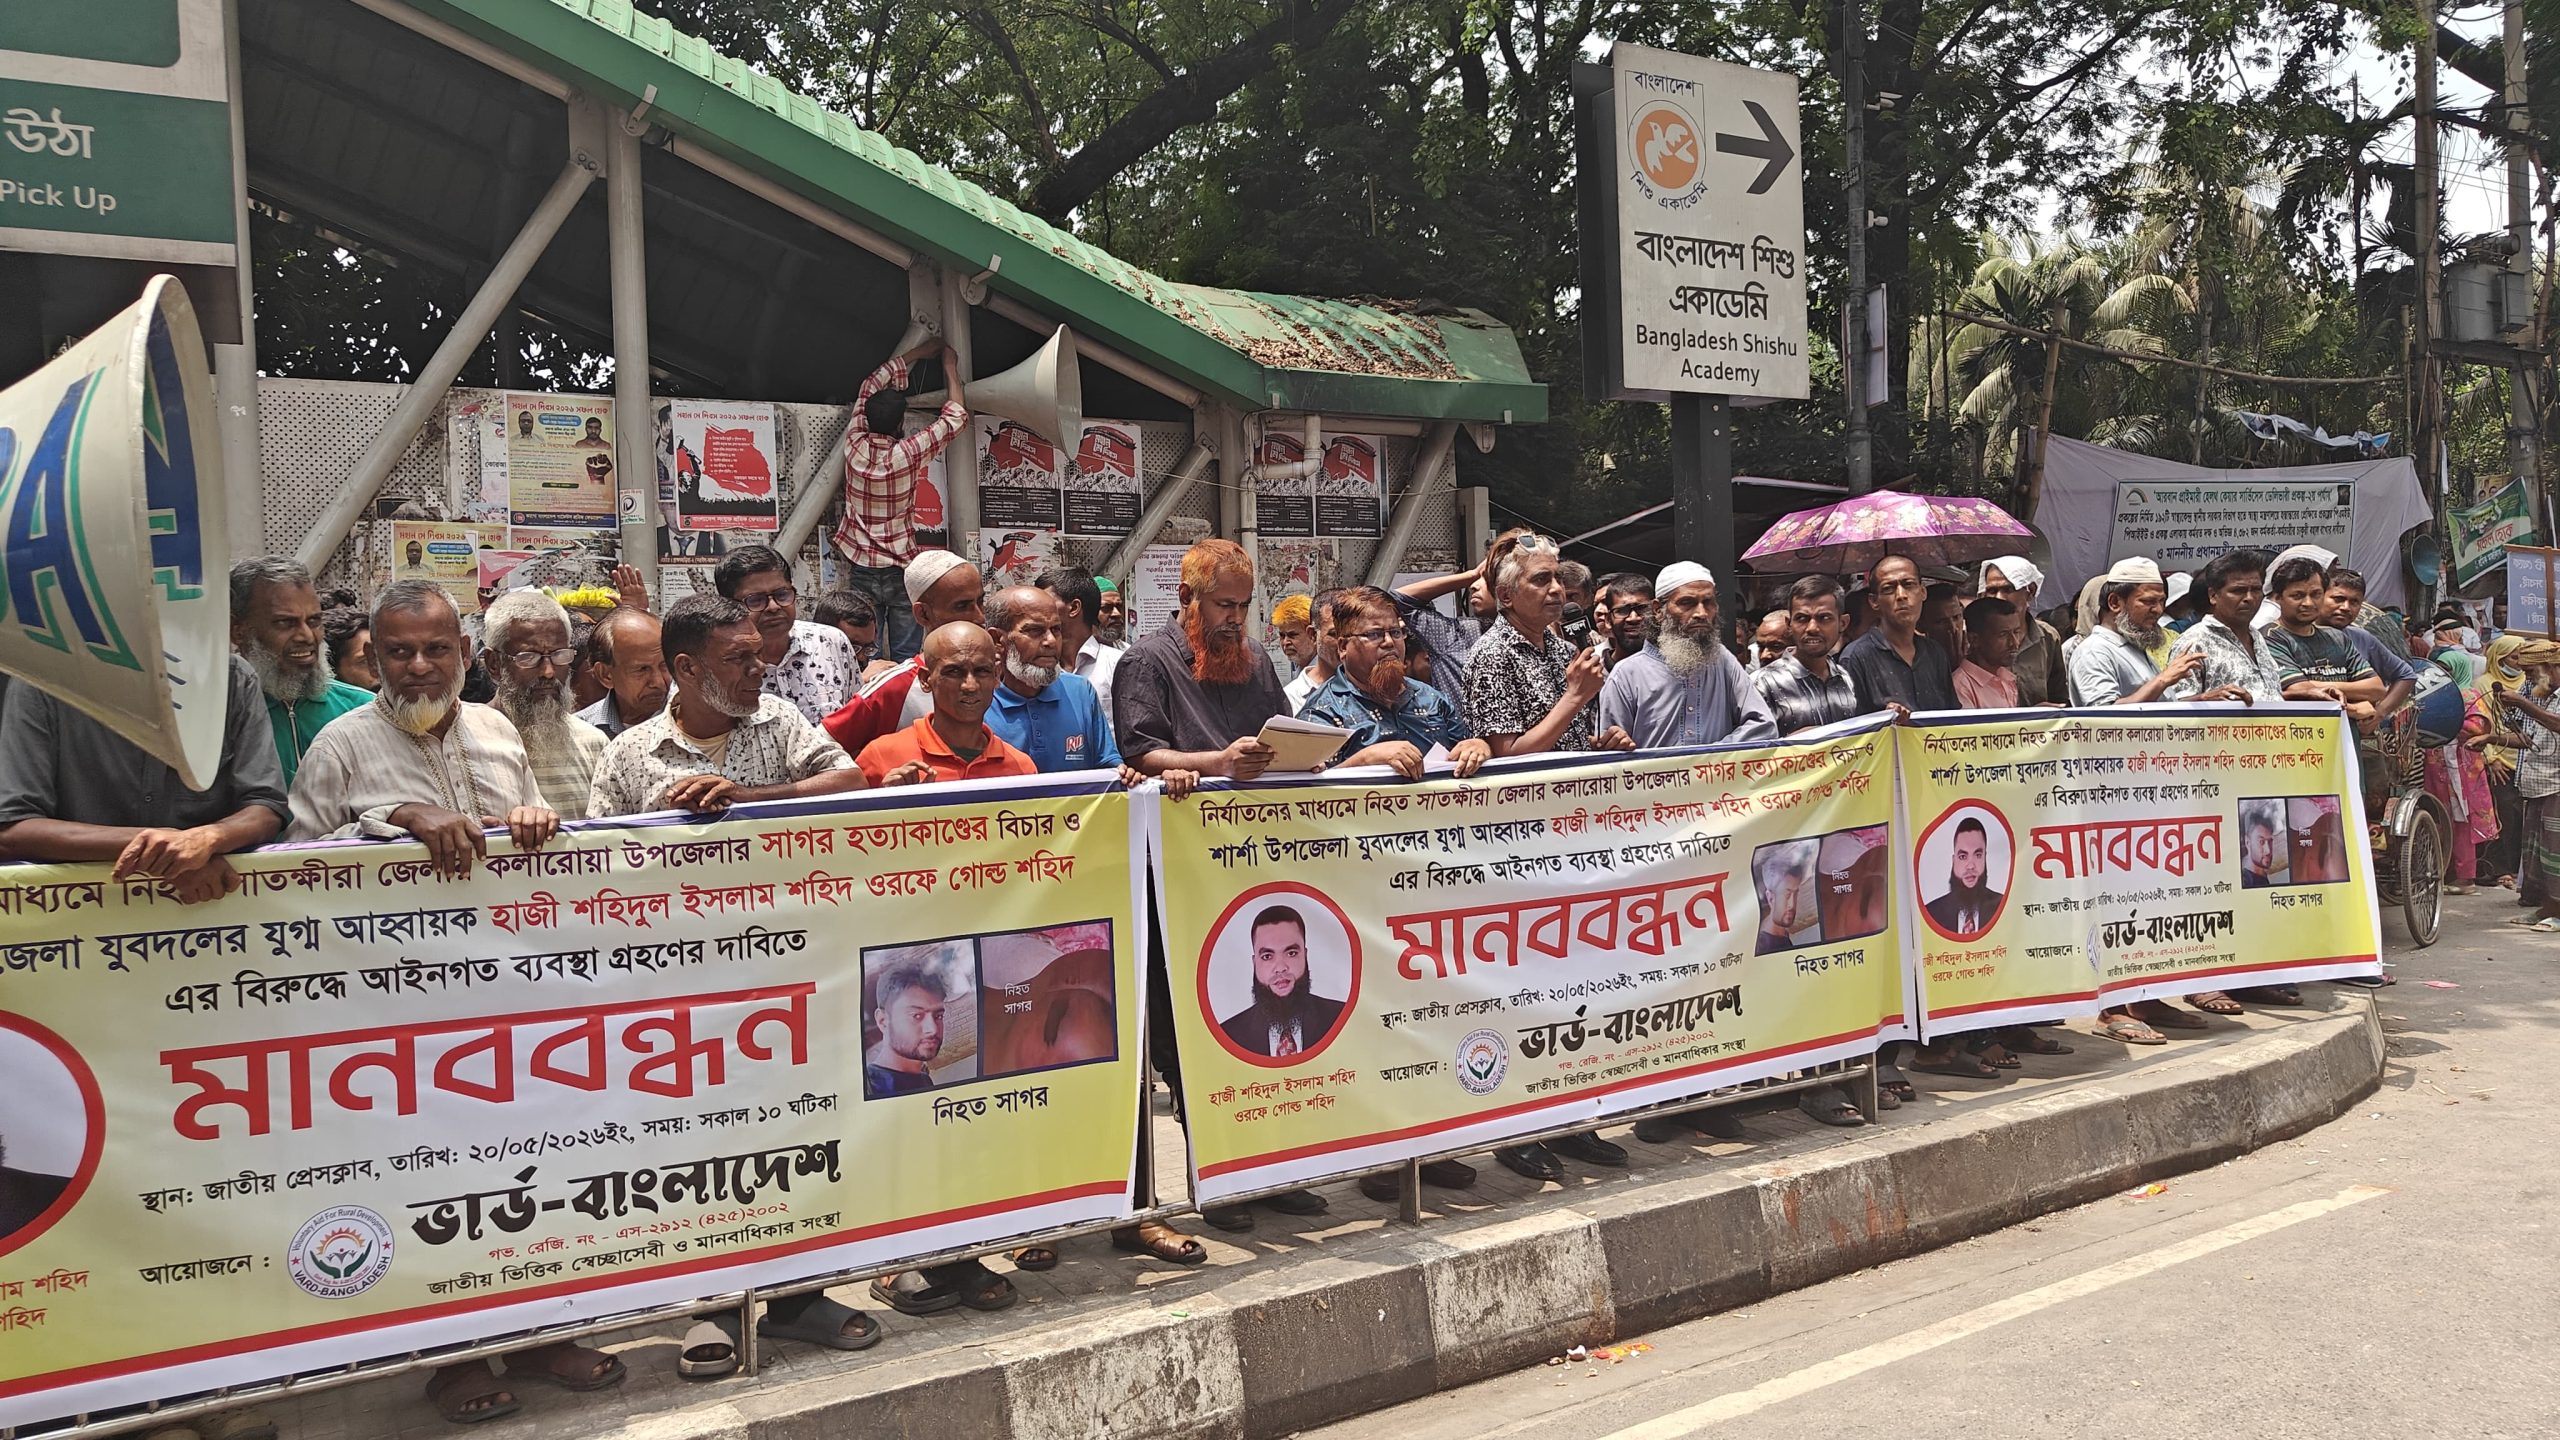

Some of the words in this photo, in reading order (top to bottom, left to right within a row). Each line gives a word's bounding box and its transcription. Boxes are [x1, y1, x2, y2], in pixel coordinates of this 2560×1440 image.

[1634, 71, 1695, 97] বাংলাদেশ
[3, 107, 95, 159] উঠা
[0, 180, 64, 207] Pick
[73, 185, 117, 215] Up
[1630, 170, 1654, 200] শিশু
[1658, 180, 1709, 211] একাডেমি
[1634, 231, 1745, 271] বাংলাদেশ
[1751, 235, 1795, 279] শিশু
[1669, 281, 1768, 320] একাডেমি
[1636, 324, 1738, 352] Bangladesh
[1743, 333, 1797, 356] Shishu
[1681, 358, 1760, 387] Academy
[2166, 542, 2194, 560] মাননীয়
[1923, 732, 1977, 754] নির্যাতনের
[1981, 734, 2016, 751] মাধ্যমে
[2019, 728, 2047, 748] নিহত
[2050, 722, 2092, 745] সাতক্ষীরা
[2096, 726, 2123, 743] জেলার
[2126, 726, 2164, 744] কলারোয়া
[2167, 725, 2205, 742] উপজেলার
[2207, 725, 2229, 743] সাগর
[2232, 724, 2287, 743] হত্যাকাণ্ডের
[2289, 723, 2313, 741] বিচার
[2316, 728, 2325, 740] ও
[1199, 798, 1292, 828] নির্যাতনের
[1297, 798, 1357, 821] মাধ্যমে
[1364, 790, 1410, 817] নিহত
[1417, 783, 1490, 812] সাতক্ষীরা
[1497, 779, 1546, 804] জেলার
[1551, 775, 1618, 799] কলারোয়া
[1622, 768, 1691, 794] উপজেলার
[1694, 761, 1736, 783] সাগর
[1741, 755, 1826, 781] হত্যাকাণ্ডের
[1208, 835, 1259, 870] শার্শা
[1262, 833, 1349, 864] উপজেলা
[1356, 829, 1429, 862] যুবদলের
[1434, 826, 1466, 855] যুগ্ম
[1551, 803, 1590, 838] হাজী
[1594, 803, 1647, 834] শহিদুল
[1653, 798, 1706, 827] ইসলাম
[1712, 793, 1753, 817] শহিদ
[1757, 789, 1802, 812] ওরফে
[1840, 771, 1872, 797] শহিদ
[120, 872, 183, 905] নিহ
[240, 859, 365, 896] াতক্ষীরা
[486, 845, 612, 880] কলারোয়া
[622, 837, 751, 872] উপজেলার
[758, 826, 834, 860] সাগর
[844, 815, 989, 854] হত্যাকাণ্ডের
[996, 810, 1055, 841] বিচার
[1063, 812, 1081, 833] ও
[1390, 869, 1419, 892] এর
[1426, 861, 1486, 889] বিরুদ্ধে
[1489, 853, 1562, 882] আইনগত
[1568, 846, 1617, 873] ব্যবস্থা
[1620, 840, 1672, 865] গ্রহণের
[1678, 831, 1732, 858] দাবিতে
[2030, 815, 2223, 880] মানববন্ধন
[95, 924, 250, 972] যুবদলের
[261, 915, 322, 957] যুগ্ম
[488, 890, 560, 935] হাজী
[570, 887, 671, 929] শহিদুল
[681, 880, 775, 918] ইসলাম
[784, 869, 854, 907] শহিদ
[864, 866, 939, 898] ওরফে
[948, 857, 1008, 891] গোল্ড
[1015, 849, 1077, 885] শহিদ
[2270, 891, 2295, 910] নিহত
[2299, 893, 2323, 907] সাগর
[1386, 870, 1730, 981] মানববন্ধন
[2101, 909, 2234, 949] ভার্ড-বাংলাদেশ
[165, 983, 222, 1014] এর
[232, 969, 348, 1009] বিরুদ্ধে
[359, 957, 500, 996] আইনগত
[509, 946, 600, 984] ব্যবস্থা
[609, 937, 706, 972] গ্রহণের
[713, 925, 808, 962] দাবিতে
[1794, 955, 1829, 977] নিহত
[1834, 949, 1865, 970] সাগর
[1004, 982, 1031, 998] নিহত
[1004, 1000, 1033, 1015] সাগর
[1518, 983, 1744, 1059] ভার্ড-বাংলাদেশ
[160, 980, 817, 1141] মানববন্ধন
[1380, 1063, 1439, 1083] আয়োজনে
[1459, 1064, 1507, 1094] VARD-BANGLADESH
[932, 1095, 987, 1126] নিহত
[994, 1085, 1049, 1115] সাগর
[1209, 1087, 1236, 1107] হাজী
[1241, 1082, 1280, 1103] শহিদুল
[1283, 1077, 1325, 1095] ইসলাম
[1328, 1068, 1357, 1086] শহিদ
[202, 1170, 277, 1201] জাতীয়
[389, 1145, 459, 1172] তারিখ:
[699, 1107, 751, 1130] সকাল
[759, 1105, 781, 1123] ১০
[787, 1092, 839, 1117] ঘটিকা
[405, 1138, 842, 1246] ভার্ড-বাংলাদেশ
[325, 1211, 337, 1221] For
[338, 1208, 357, 1218] Rural
[356, 1209, 390, 1238] Development
[576, 1233, 597, 1247] নং
[139, 1254, 254, 1285] আয়োজনে
[428, 1271, 493, 1297] জাতীয়
[500, 1258, 563, 1285] ভিত্তিক
[571, 1239, 666, 1272] স্বেচ্ছাসেবী
[674, 1240, 689, 1254] ও
[696, 1220, 795, 1251] মানবাধিকার
[801, 1211, 841, 1232] সংস্থা
[34, 1269, 90, 1294] শহিদ
[294, 1256, 391, 1297] VARD-BANGLADESH
